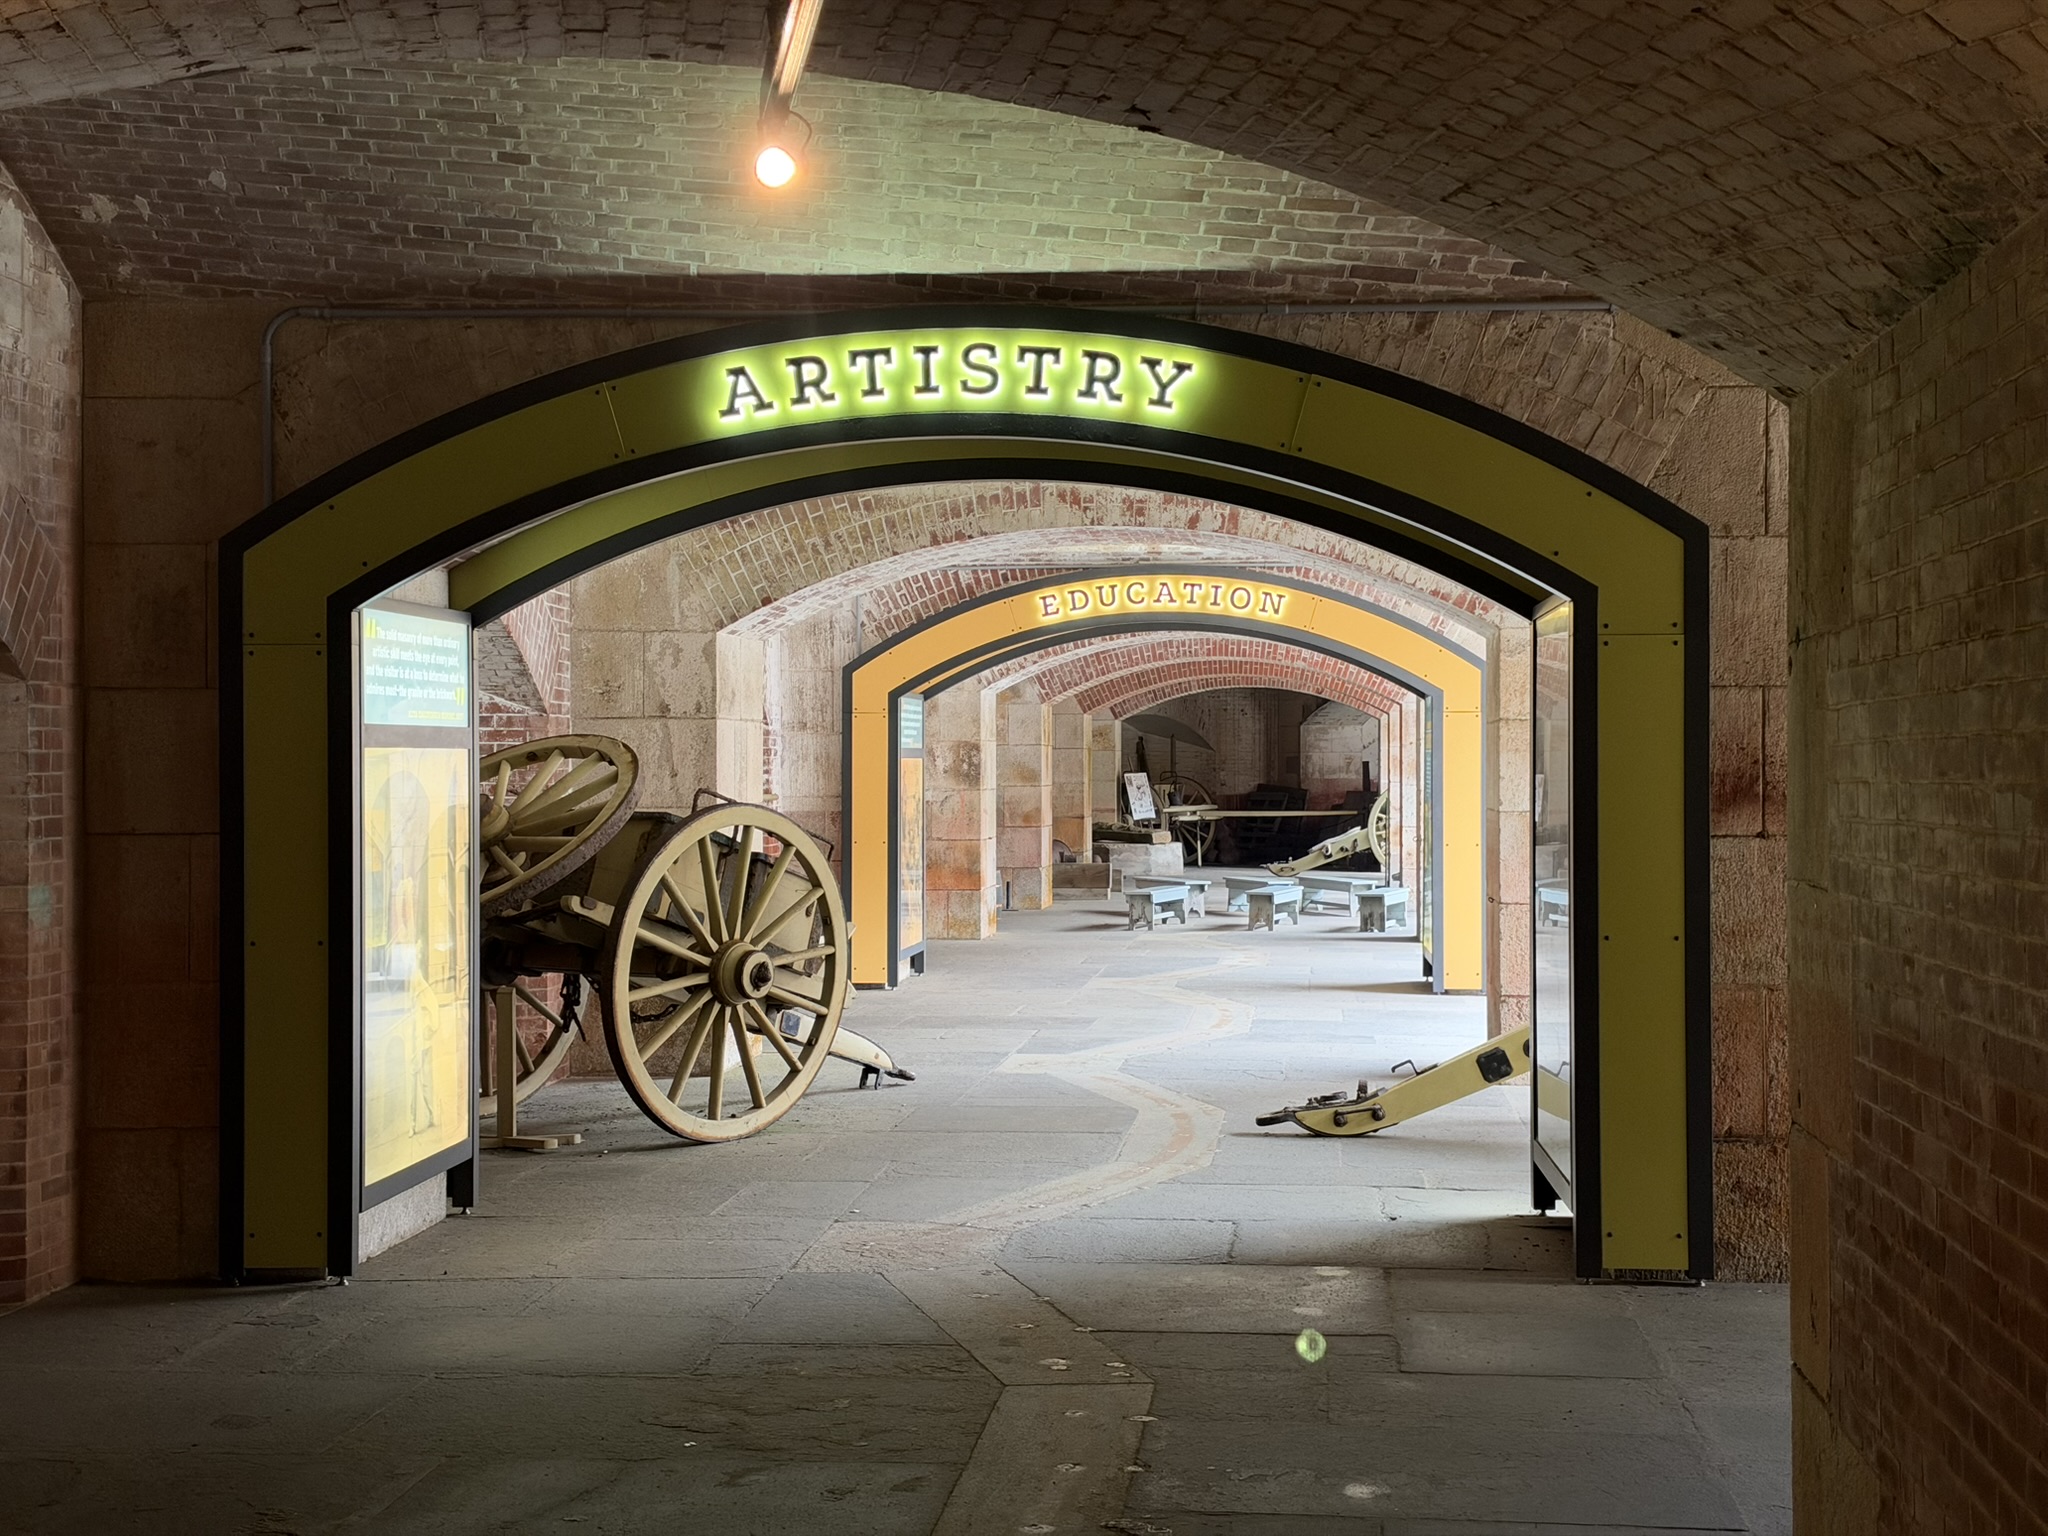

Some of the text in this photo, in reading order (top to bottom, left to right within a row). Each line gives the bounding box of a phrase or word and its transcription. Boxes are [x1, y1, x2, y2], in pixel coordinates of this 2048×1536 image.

[718, 343, 1194, 419] ARTISTRY
[1038, 582, 1286, 617] EDUCATION
[386, 629, 397, 641] solid
[398, 632, 416, 646] masonry
[433, 635, 443, 647] than
[372, 645, 390, 658] artistic
[390, 646, 400, 659] skill
[401, 649, 414, 661] meets
[422, 653, 430, 665] eye
[366, 664, 375, 676] and
[375, 664, 383, 676] the
[384, 665, 399, 677] visitor
[428, 670, 449, 682] determine
